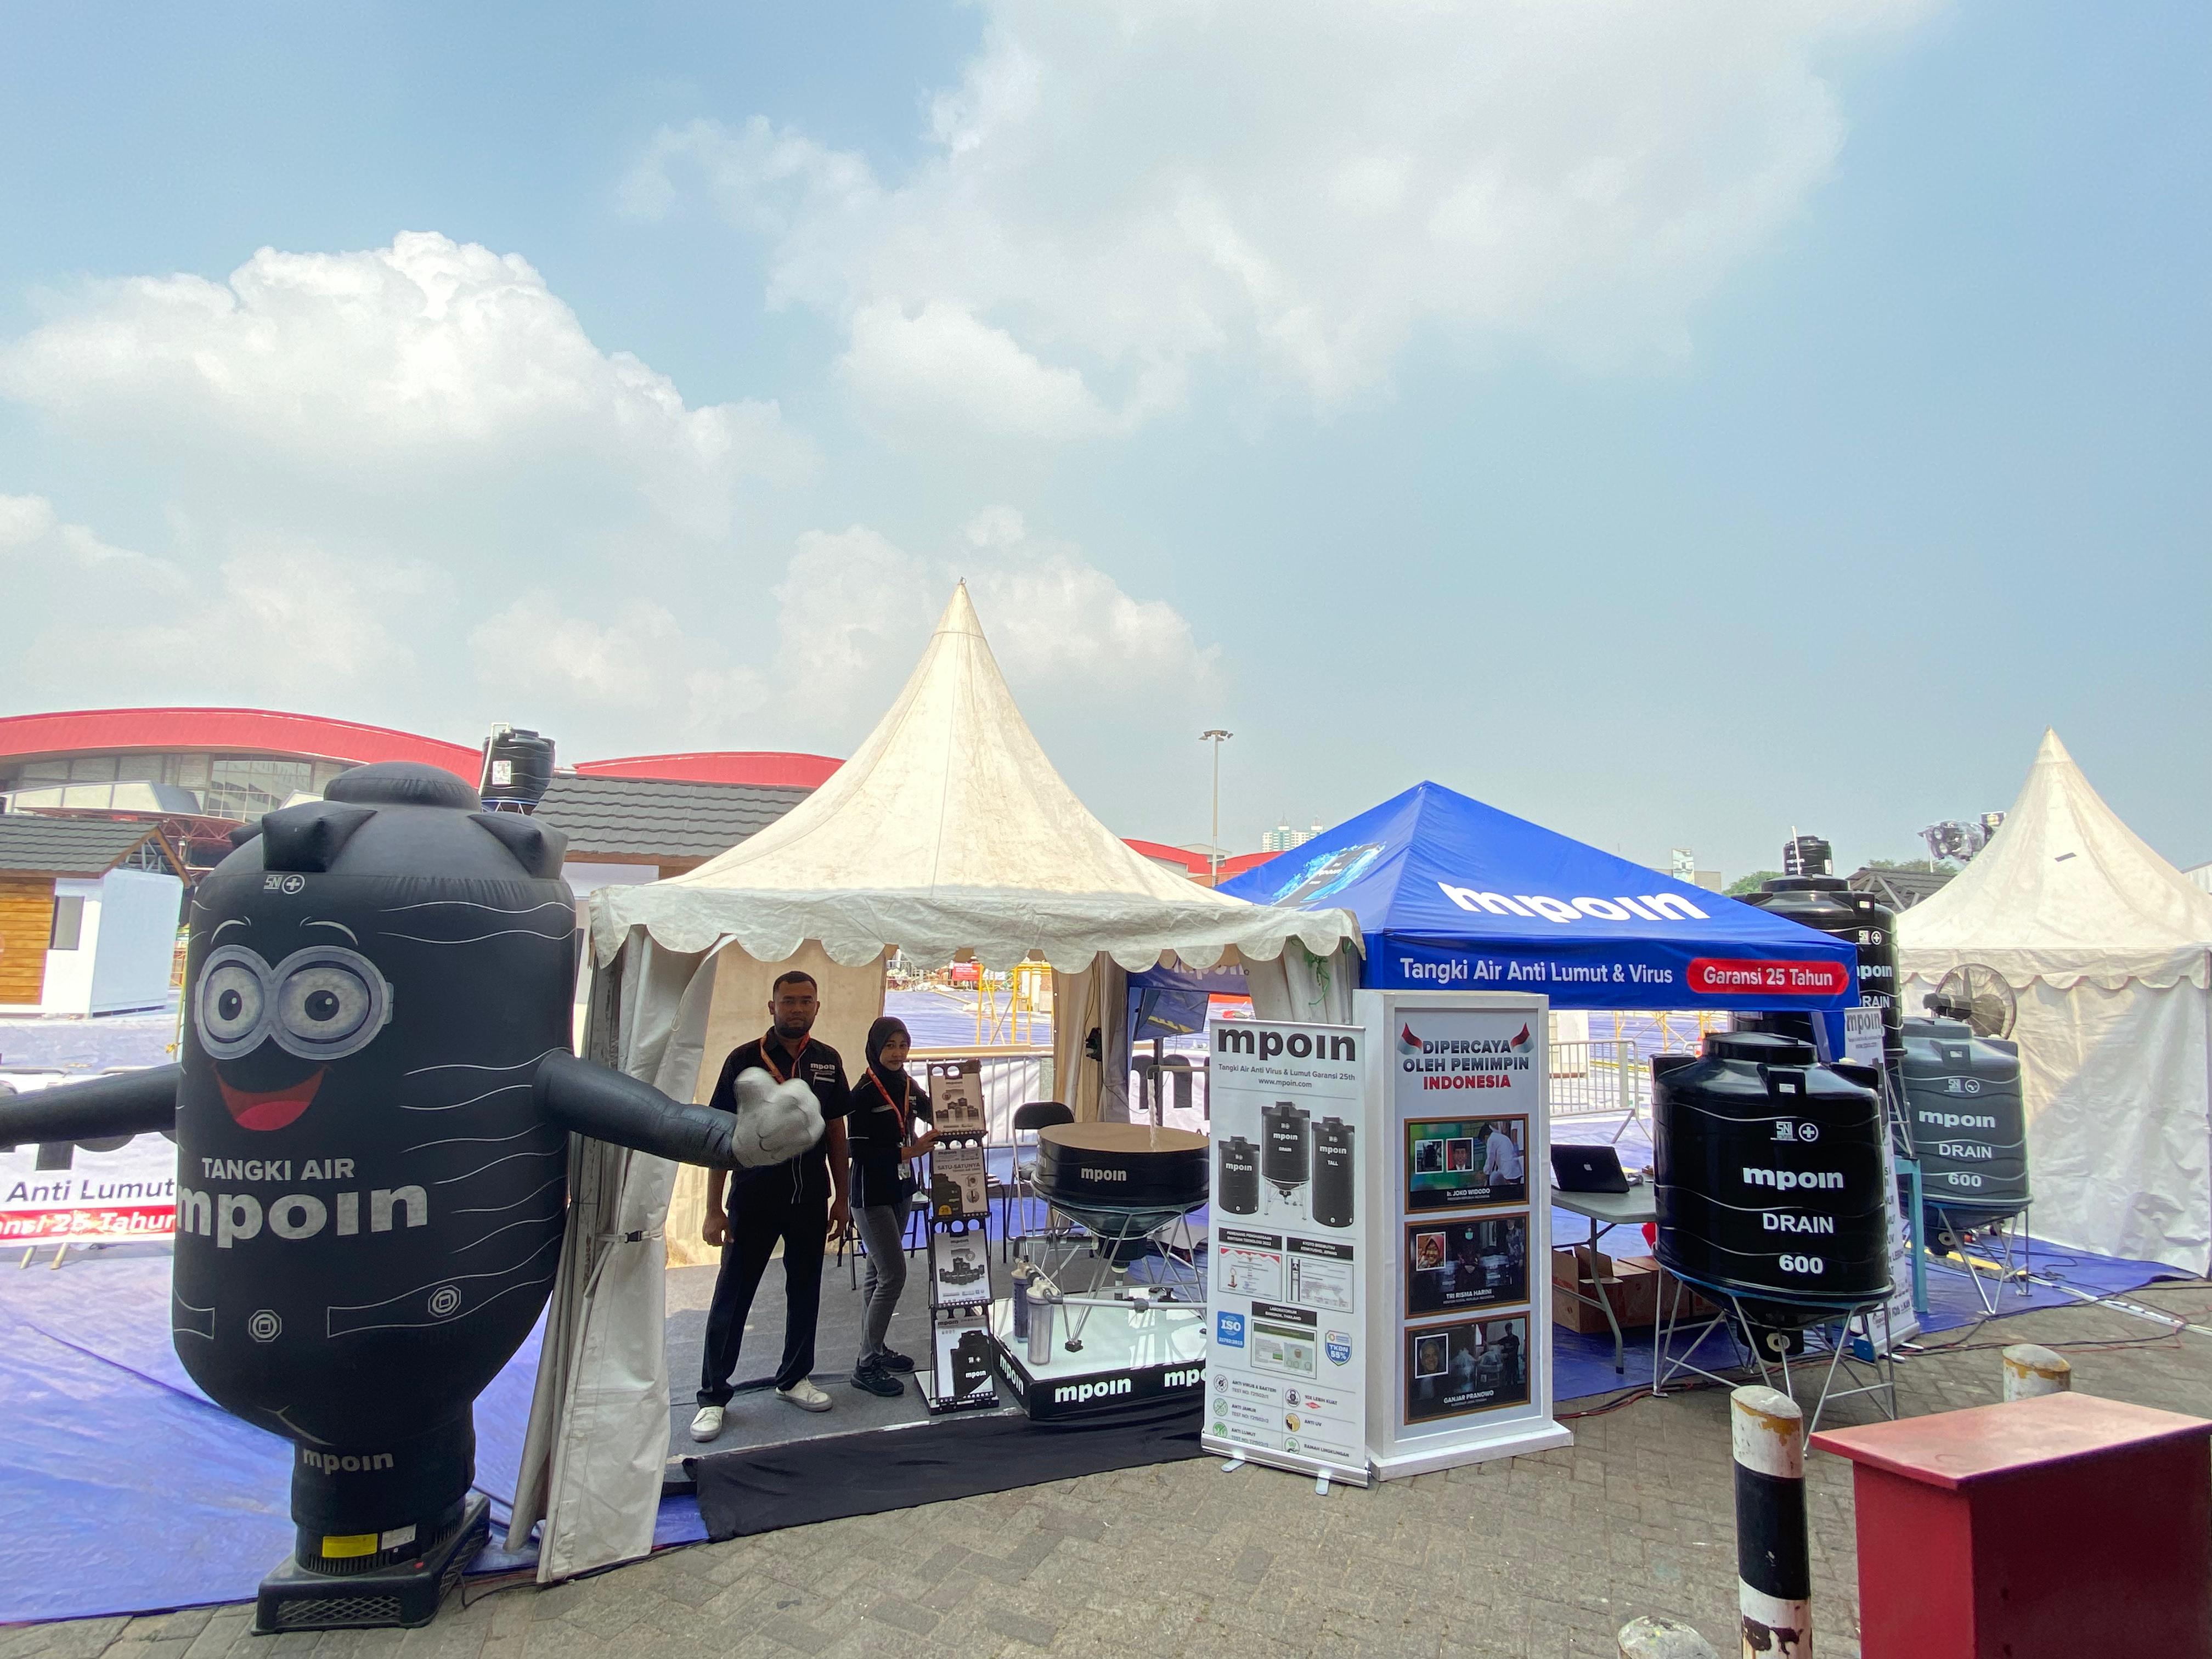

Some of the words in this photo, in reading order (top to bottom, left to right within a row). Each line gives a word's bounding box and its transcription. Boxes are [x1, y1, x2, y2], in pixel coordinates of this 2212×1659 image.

[1437, 881, 1711, 923] mpoin
[1400, 958, 1468, 983] Tangki
[1473, 960, 1503, 980] Air
[1507, 961, 1545, 981] Anti
[1551, 962, 1609, 983] Lumut
[1612, 964, 1625, 983] &
[1628, 963, 1673, 984] Virus
[1703, 966, 1762, 985] Garansi
[1766, 968, 1785, 986] 25
[1789, 968, 1833, 986] Tahun
[1859, 995, 1890, 1008] RAIN
[1847, 1013, 1881, 1035] mpoin
[1218, 1029, 1356, 1062] mpoin
[1423, 1040, 1511, 1054] DIPERCAYA
[1219, 1064, 1239, 1073] Tangki
[1312, 1071, 1338, 1079] Garansi
[1403, 1058, 1446, 1072] OLEH
[1451, 1057, 1530, 1071] PEMIMPIN
[1259, 1079, 1312, 1088] www.mpoin.com
[1424, 1075, 1511, 1090] INDONESIA
[1918, 1110, 1996, 1128] mpoin
[1273, 1132, 1298, 1141] mpoin
[1319, 1146, 1347, 1154] mpoin
[1938, 1143, 1992, 1159] DRAIN
[201, 1158, 291, 1181] TANGKI
[300, 1158, 356, 1181] AIR
[1081, 1168, 1127, 1182] mpoin
[1225, 1163, 1252, 1171] mpoin
[1742, 1167, 1844, 1190] mpoin
[1948, 1172, 1982, 1187] 600
[5, 1180, 71, 1202] Anti
[81, 1178, 175, 1200] Lumut
[177, 1184, 428, 1249] mpoin
[1762, 1212, 1834, 1233] DRAIN
[1779, 1254, 1824, 1274] 600
[1221, 1319, 1241, 1331] ISO
[1329, 1344, 1348, 1353] TKDN
[1000, 1354, 1024, 1396] mpoin
[1054, 1378, 1132, 1403] mpoin
[1443, 1395, 1466, 1403] GANJAR
[1466, 1390, 1494, 1400] PRANOWO
[303, 1449, 394, 1475] mpoin
